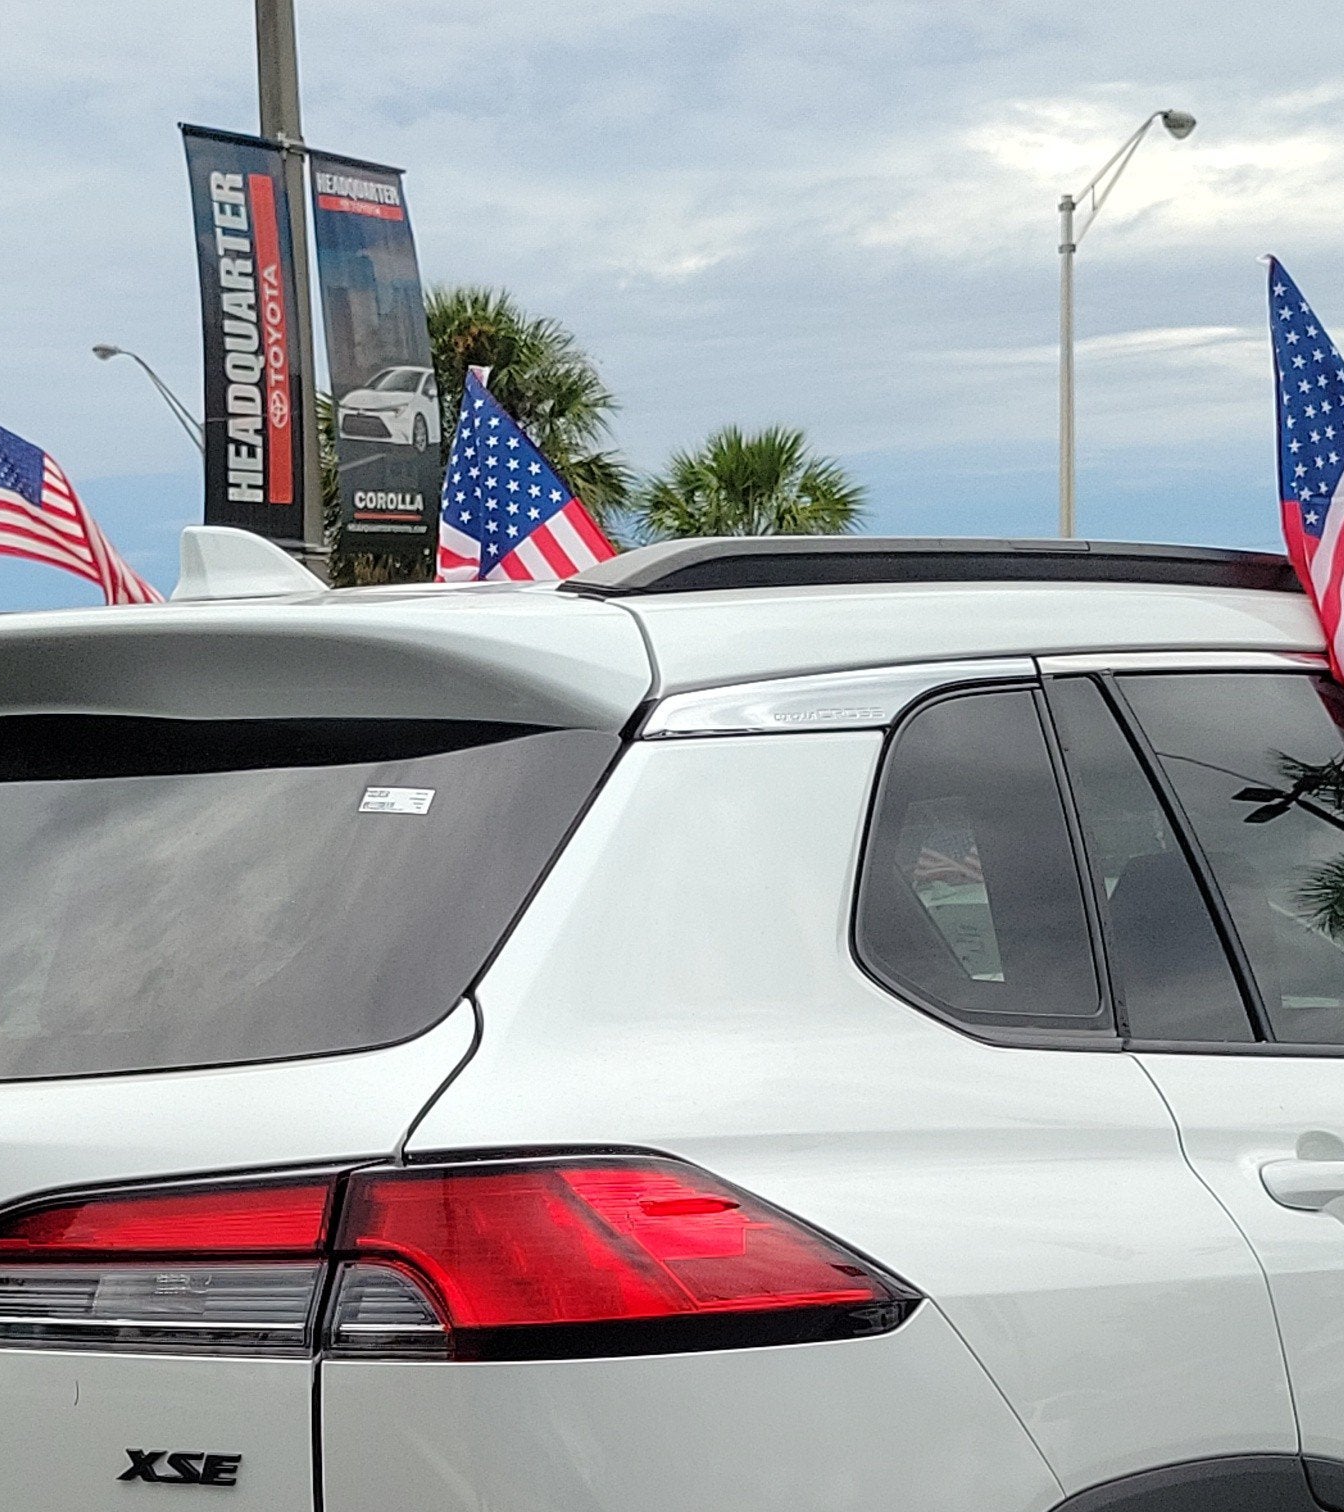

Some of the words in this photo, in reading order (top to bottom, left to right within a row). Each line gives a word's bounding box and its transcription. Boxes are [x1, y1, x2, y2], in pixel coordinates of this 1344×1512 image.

[316, 171, 401, 206] HEADQUARTER
[210, 170, 265, 503] HEADQUARTER
[261, 264, 286, 388] TOYOTA
[354, 490, 424, 511] COROLLA
[116, 1449, 242, 1487] XSE
